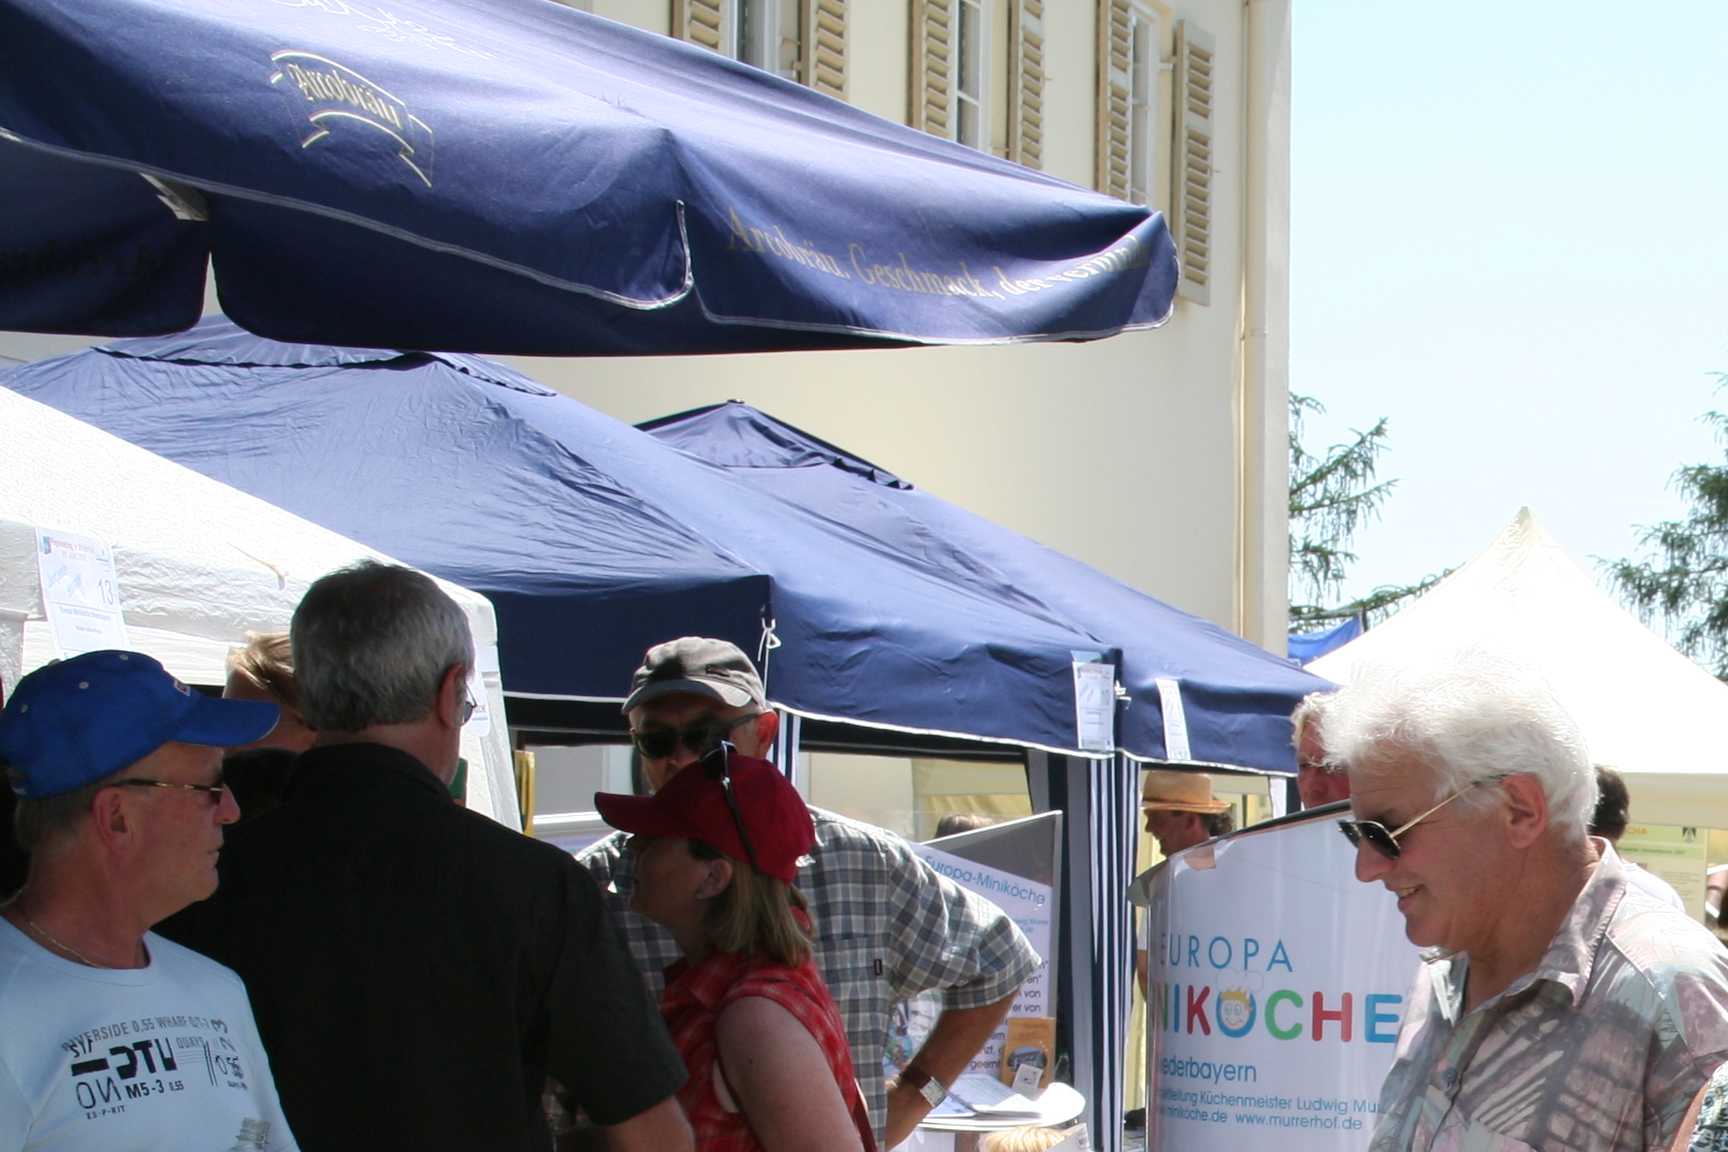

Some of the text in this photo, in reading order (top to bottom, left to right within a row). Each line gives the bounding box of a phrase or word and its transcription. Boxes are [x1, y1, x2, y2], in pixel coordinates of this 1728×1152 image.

[992, 265, 1054, 297] der
[1200, 1089, 1293, 1109] Küchenmeister
[1297, 1095, 1348, 1114] Ludwig
[1235, 1113, 1363, 1131] www.murrerhof.de
